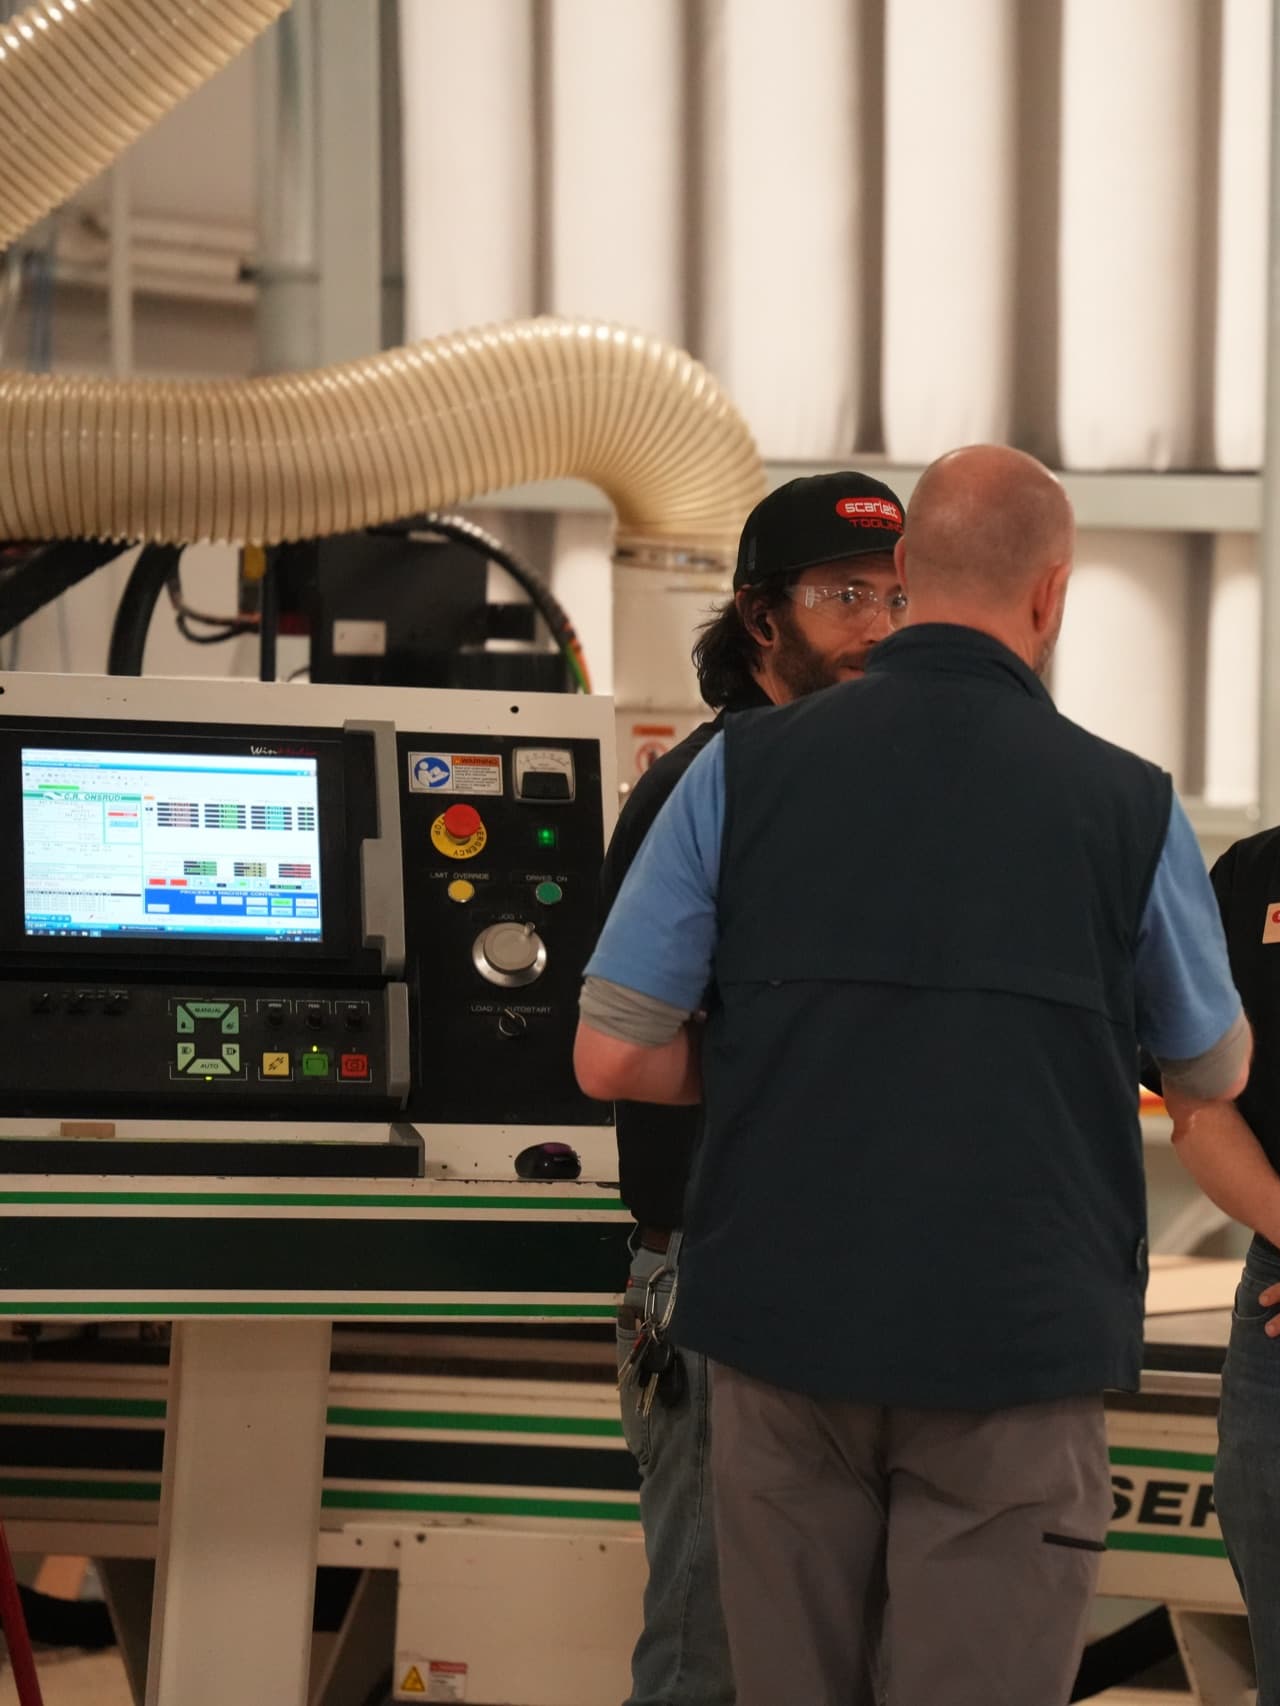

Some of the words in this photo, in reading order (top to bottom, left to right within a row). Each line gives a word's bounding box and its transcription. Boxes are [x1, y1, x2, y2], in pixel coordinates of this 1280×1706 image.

[844, 501, 899, 519] scarlett
[447, 826, 485, 857] ERGENCY
[453, 872, 490, 880] OVERRIDE
